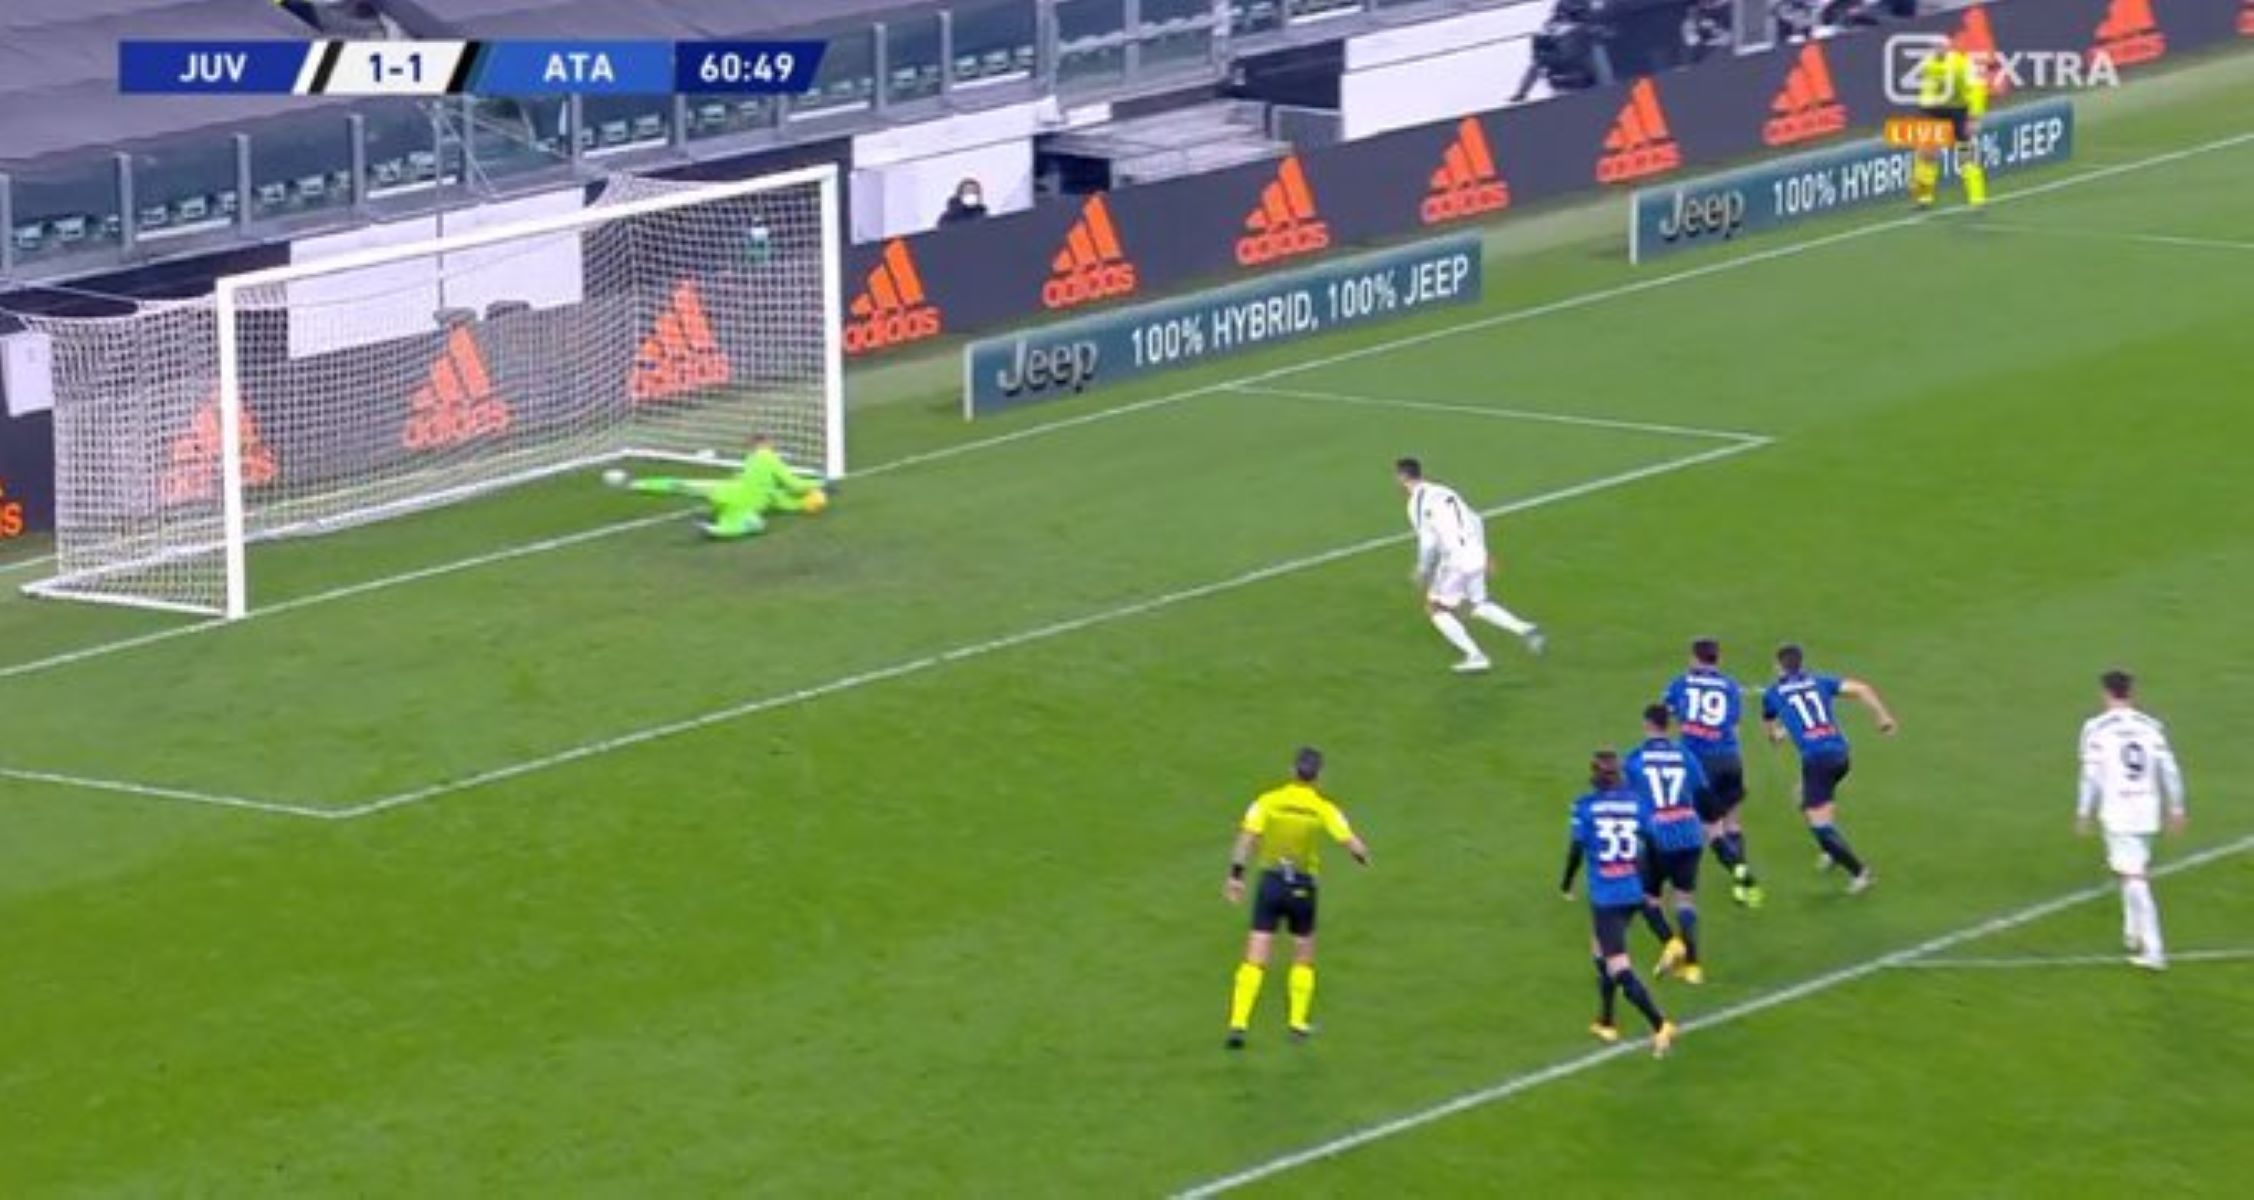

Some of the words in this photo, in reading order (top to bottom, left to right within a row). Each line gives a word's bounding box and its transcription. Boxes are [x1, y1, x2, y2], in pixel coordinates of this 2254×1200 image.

[1658, 188, 1744, 240] Jeep
[1773, 168, 1837, 215] 100%
[2006, 116, 2064, 163] JEEP
[1042, 261, 1136, 309] adidas
[845, 303, 940, 353] adidas
[996, 338, 1098, 396] Jeep
[1131, 314, 1205, 368] 100%
[1327, 269, 1398, 321] 100%
[1403, 253, 1469, 306] JEEP
[1685, 687, 1728, 727] 19
[1788, 690, 1829, 730] 11
[2120, 741, 2147, 781] 9
[1644, 767, 1686, 808] 17
[1594, 817, 1639, 862] 33
